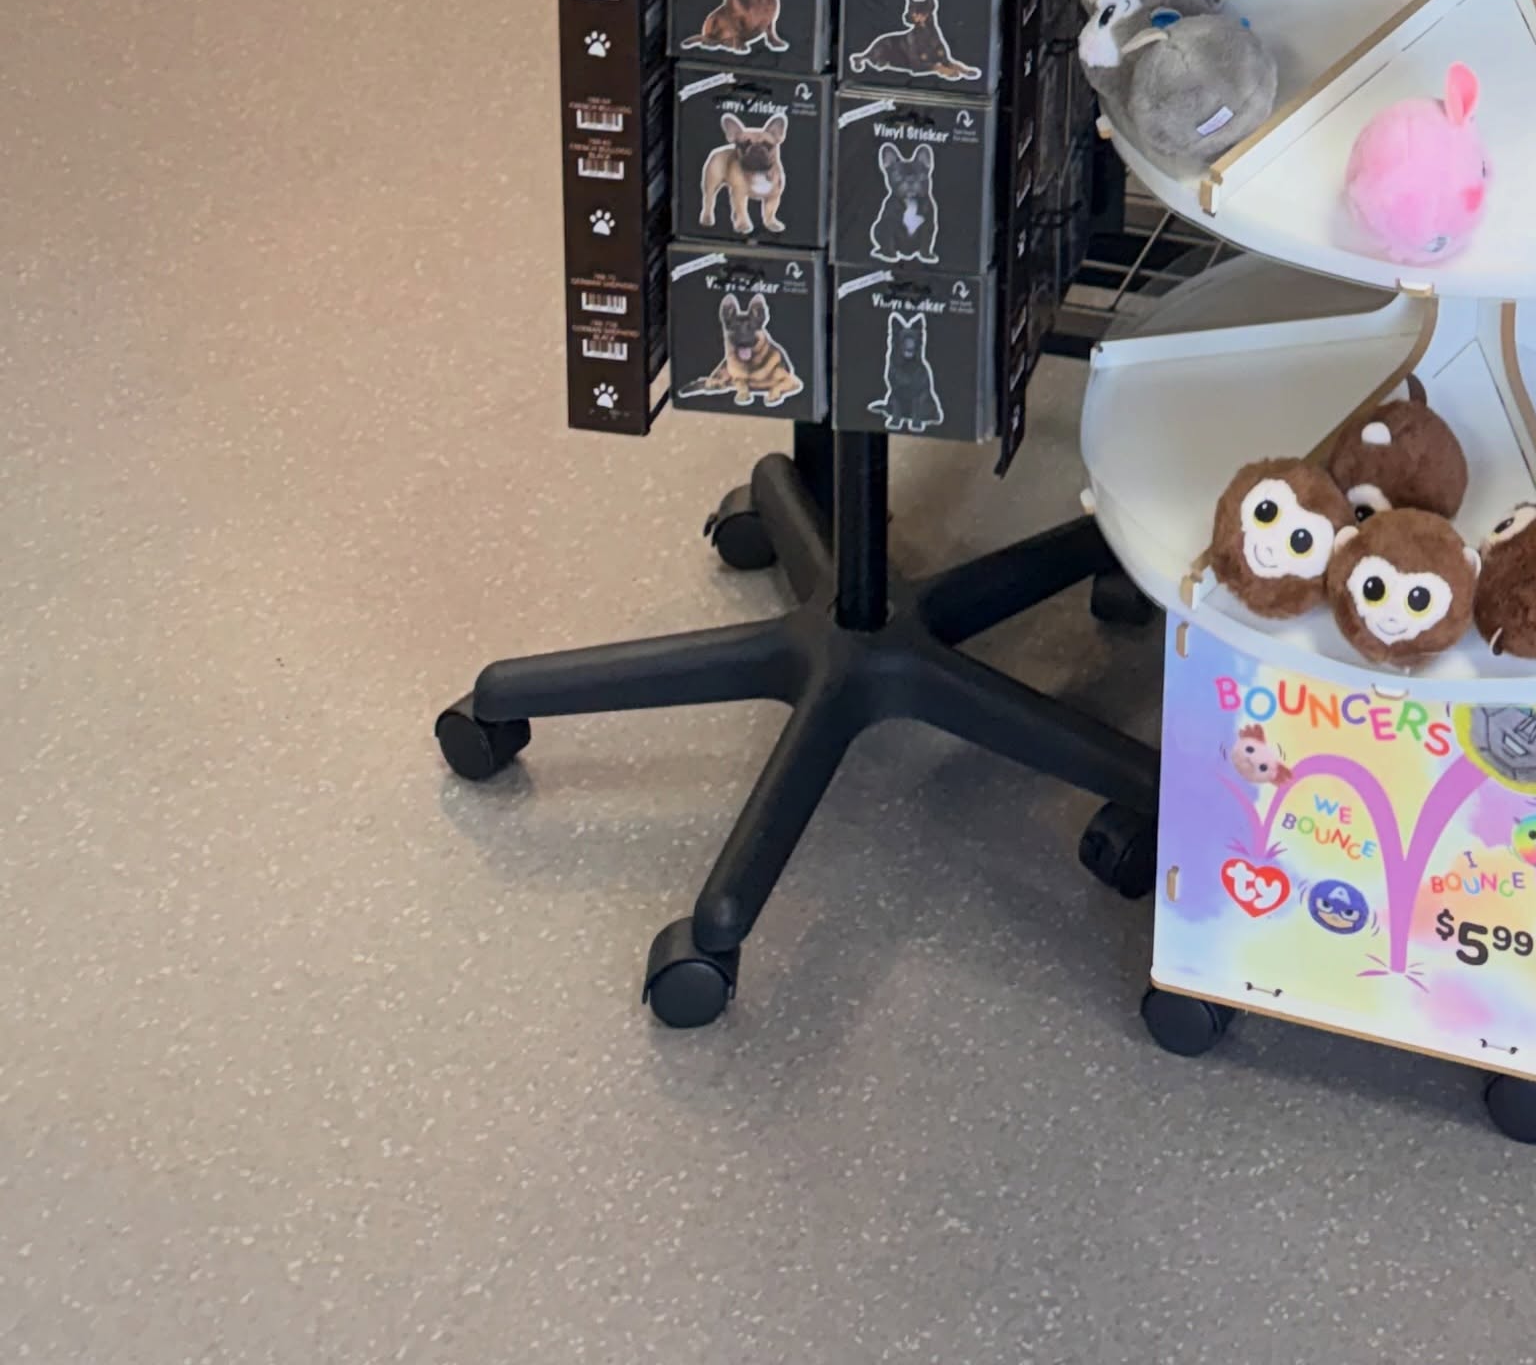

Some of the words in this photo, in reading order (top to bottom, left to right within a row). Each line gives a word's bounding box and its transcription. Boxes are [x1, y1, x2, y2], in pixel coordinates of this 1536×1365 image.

[1215, 676, 1452, 757] BOUNCERS
[1313, 793, 1353, 826] WE
[1281, 812, 1377, 861] BOUNCE
[1463, 850, 1478, 868] I
[1225, 864, 1284, 909] ty
[1430, 870, 1526, 899] BOUNCE
